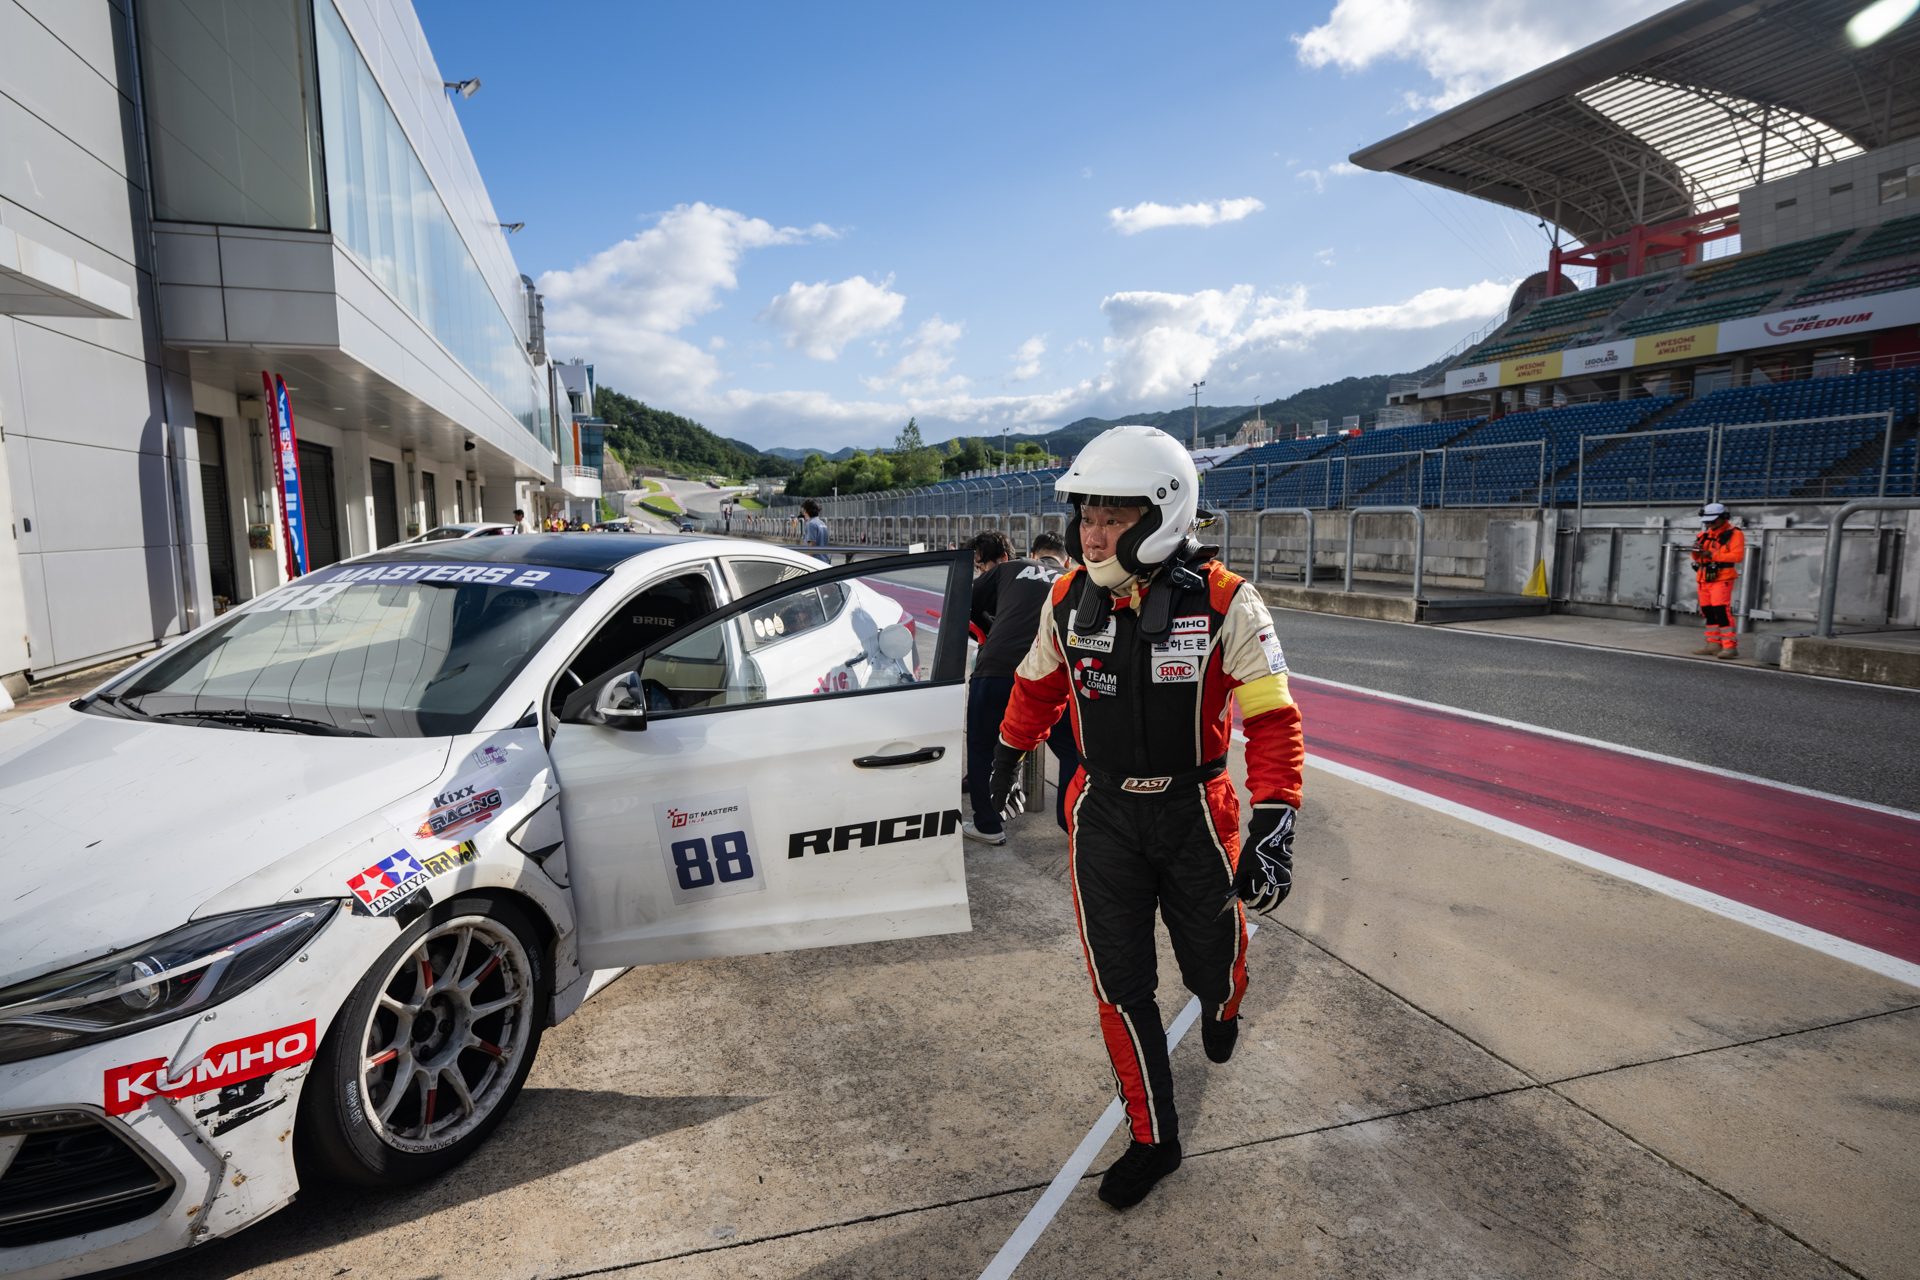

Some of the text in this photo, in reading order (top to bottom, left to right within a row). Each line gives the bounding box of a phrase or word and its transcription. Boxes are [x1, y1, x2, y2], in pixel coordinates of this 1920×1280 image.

[1764, 312, 1874, 336] SPEEDIUM
[1654, 335, 1697, 349] AWESOME
[1514, 361, 1547, 372] AWESOME
[1584, 355, 1619, 366] LEGOLAND
[325, 564, 551, 587] MASTERS 2
[241, 581, 355, 615] 88
[632, 615, 676, 628] BRIDE
[1077, 636, 1111, 648] MOTON
[1170, 638, 1208, 652] 하드론
[1086, 670, 1117, 685] TEAM
[1160, 666, 1192, 677] BMC
[1086, 680, 1117, 692] CORNER
[1138, 779, 1168, 788] AST
[433, 784, 476, 808] Kixx
[428, 789, 503, 832] RACING
[688, 805, 739, 820] GT MASTERS
[671, 830, 754, 890] 88
[370, 873, 431, 913] TAMIYA
[117, 1032, 308, 1103] KUMHO
[390, 1135, 459, 1152] PERFORMANCE
